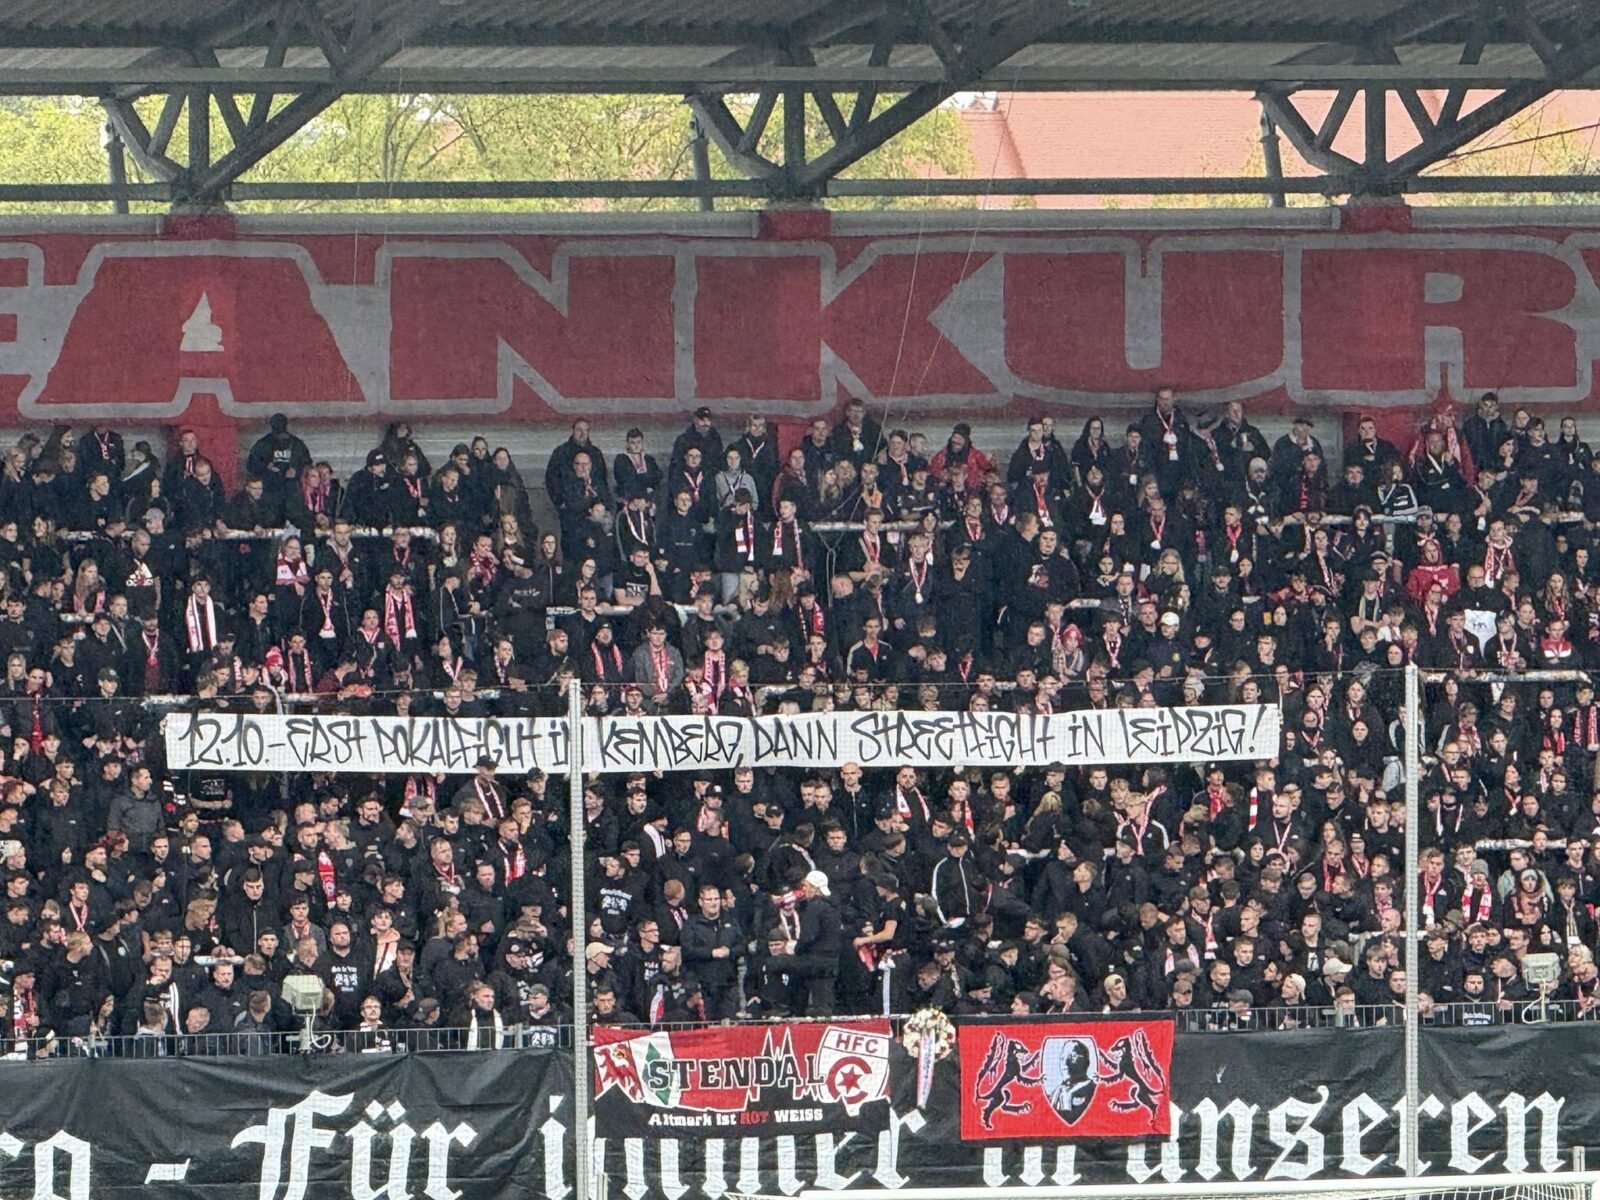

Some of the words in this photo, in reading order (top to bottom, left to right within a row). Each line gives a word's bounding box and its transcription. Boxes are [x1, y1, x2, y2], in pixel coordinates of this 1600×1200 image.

[0, 238, 1600, 420] ANKUR
[751, 716, 837, 762] DANN
[835, 1032, 880, 1054] HFC
[646, 1053, 828, 1092] STENDAL
[649, 1112, 710, 1128] Altmark
[740, 1110, 769, 1125] ROT
[774, 1108, 824, 1124] WEISS
